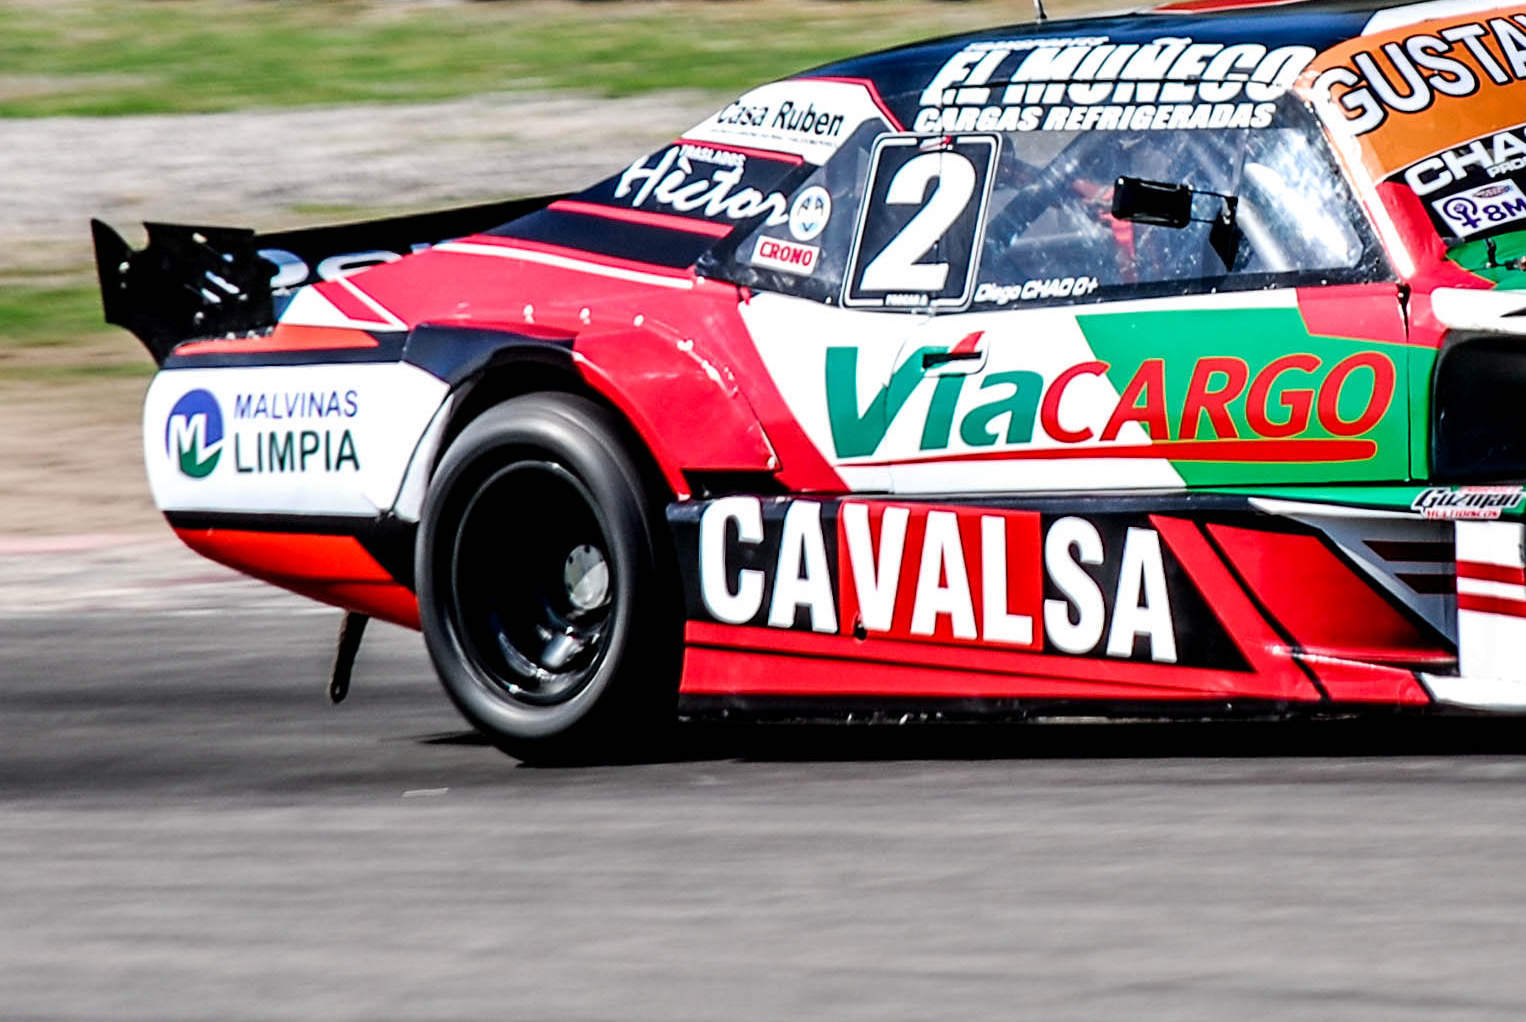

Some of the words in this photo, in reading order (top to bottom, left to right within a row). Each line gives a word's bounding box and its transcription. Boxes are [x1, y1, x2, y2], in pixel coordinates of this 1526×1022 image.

[716, 100, 769, 126] Casa
[772, 100, 845, 137] Ruben
[914, 106, 1043, 132] CARGAS
[1042, 102, 1276, 131] REFRIGERADAS
[860, 151, 978, 291] 2
[233, 389, 359, 419] MALVINAS
[234, 429, 361, 473] LIMPIA
[700, 495, 1178, 664] CAVALSA
